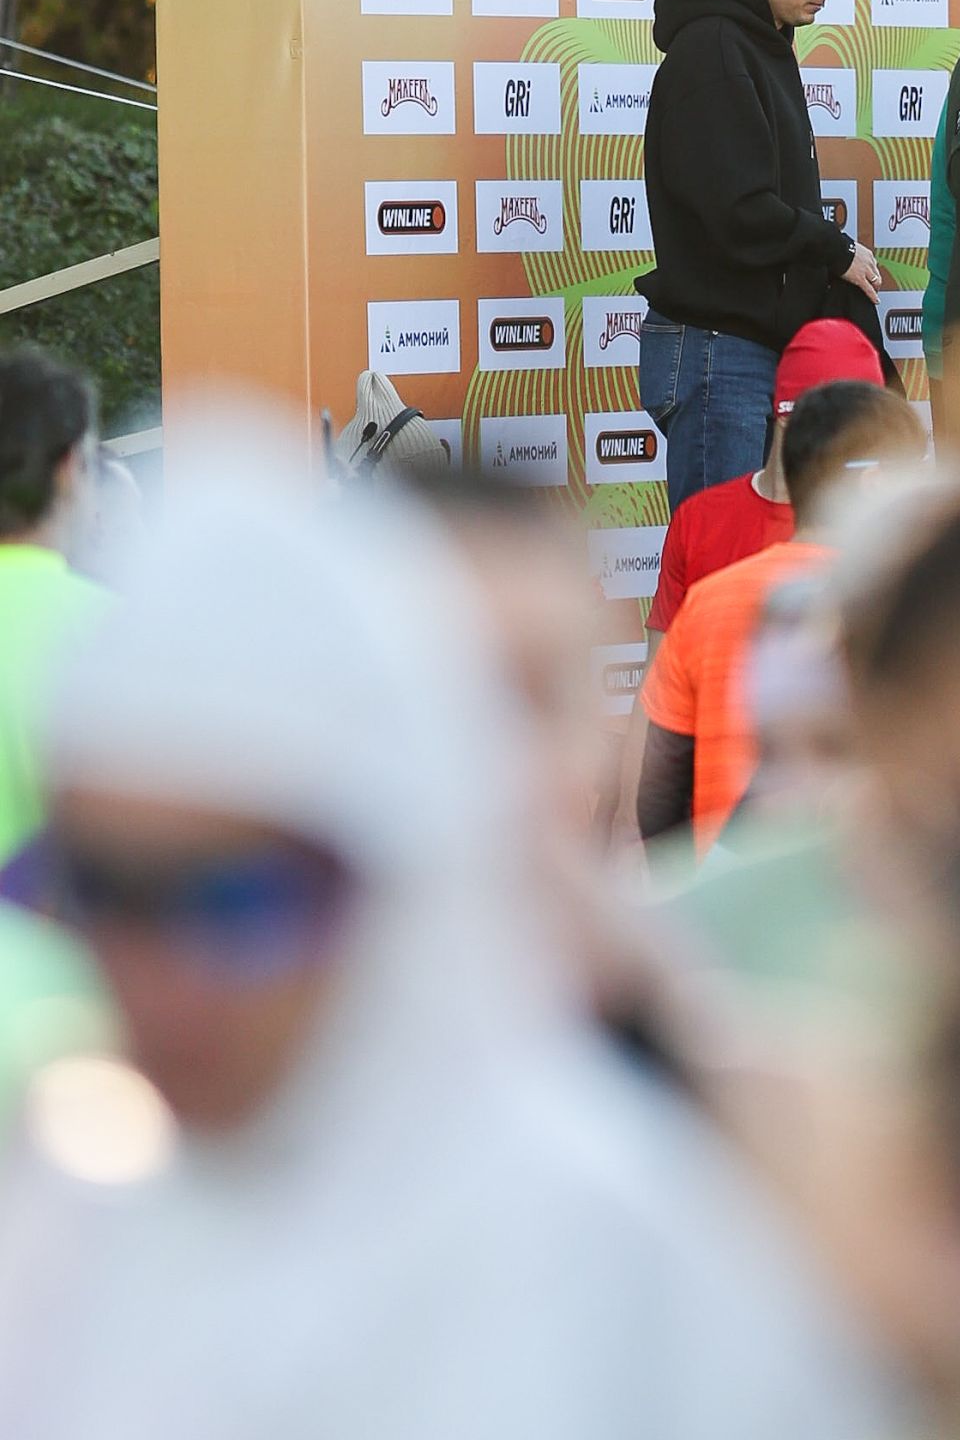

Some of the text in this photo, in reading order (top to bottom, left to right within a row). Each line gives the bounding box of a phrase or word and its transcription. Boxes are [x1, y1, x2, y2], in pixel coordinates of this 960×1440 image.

[505, 80, 531, 117] GRi
[900, 87, 923, 121] GRi
[383, 207, 431, 227] WINLINE
[610, 196, 635, 234] GRi
[495, 324, 540, 343] WINLINE
[890, 314, 922, 334] WINLIN
[399, 328, 449, 348] АММОНИЙ
[510, 442, 557, 462] АММОНИЙ
[601, 437, 644, 457] WINLINE
[615, 553, 660, 572] АММОНИЙ
[607, 669, 642, 689] WINLIN
